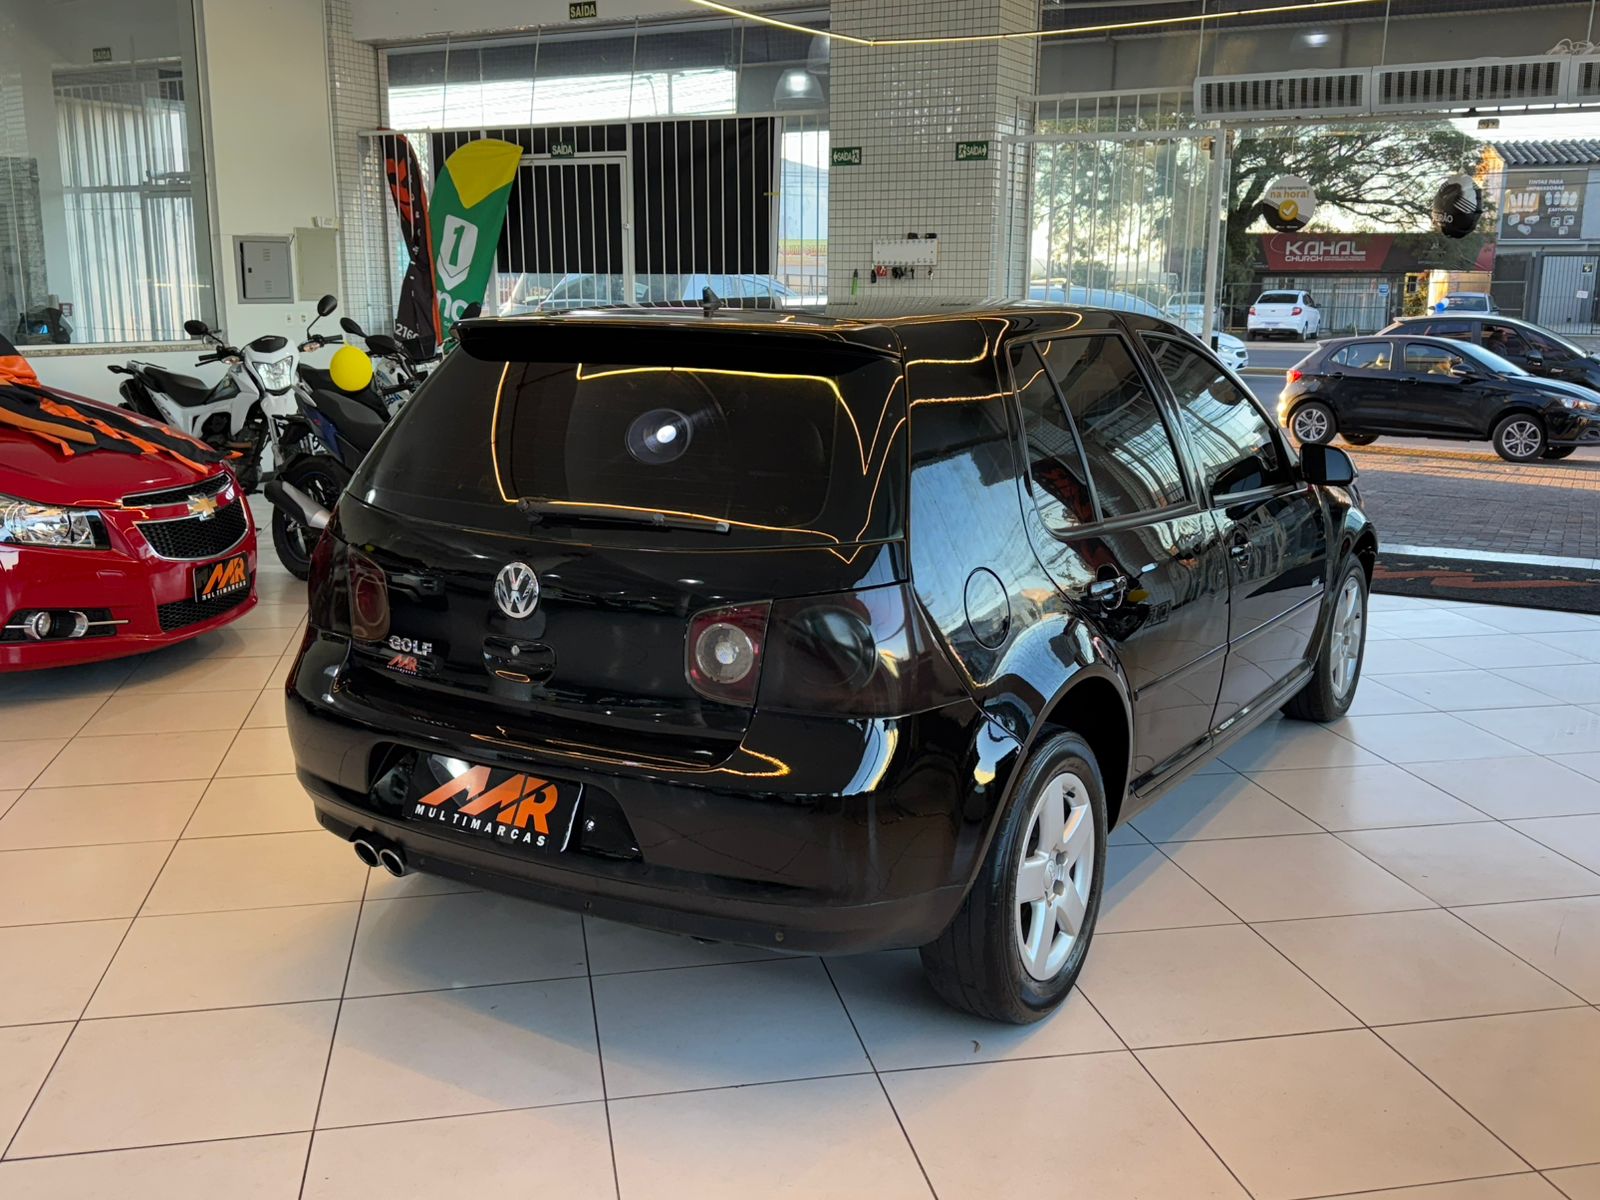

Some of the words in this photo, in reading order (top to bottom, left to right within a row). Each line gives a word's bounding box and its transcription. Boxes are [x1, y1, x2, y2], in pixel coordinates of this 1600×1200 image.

[570, 4, 596, 18] SAÍDA
[552, 142, 573, 156] SAÍDA
[1270, 191, 1282, 199] na
[1283, 189, 1310, 199] hora!
[388, 635, 433, 656] GOLF
[414, 803, 547, 847] MULTIMARCAS
